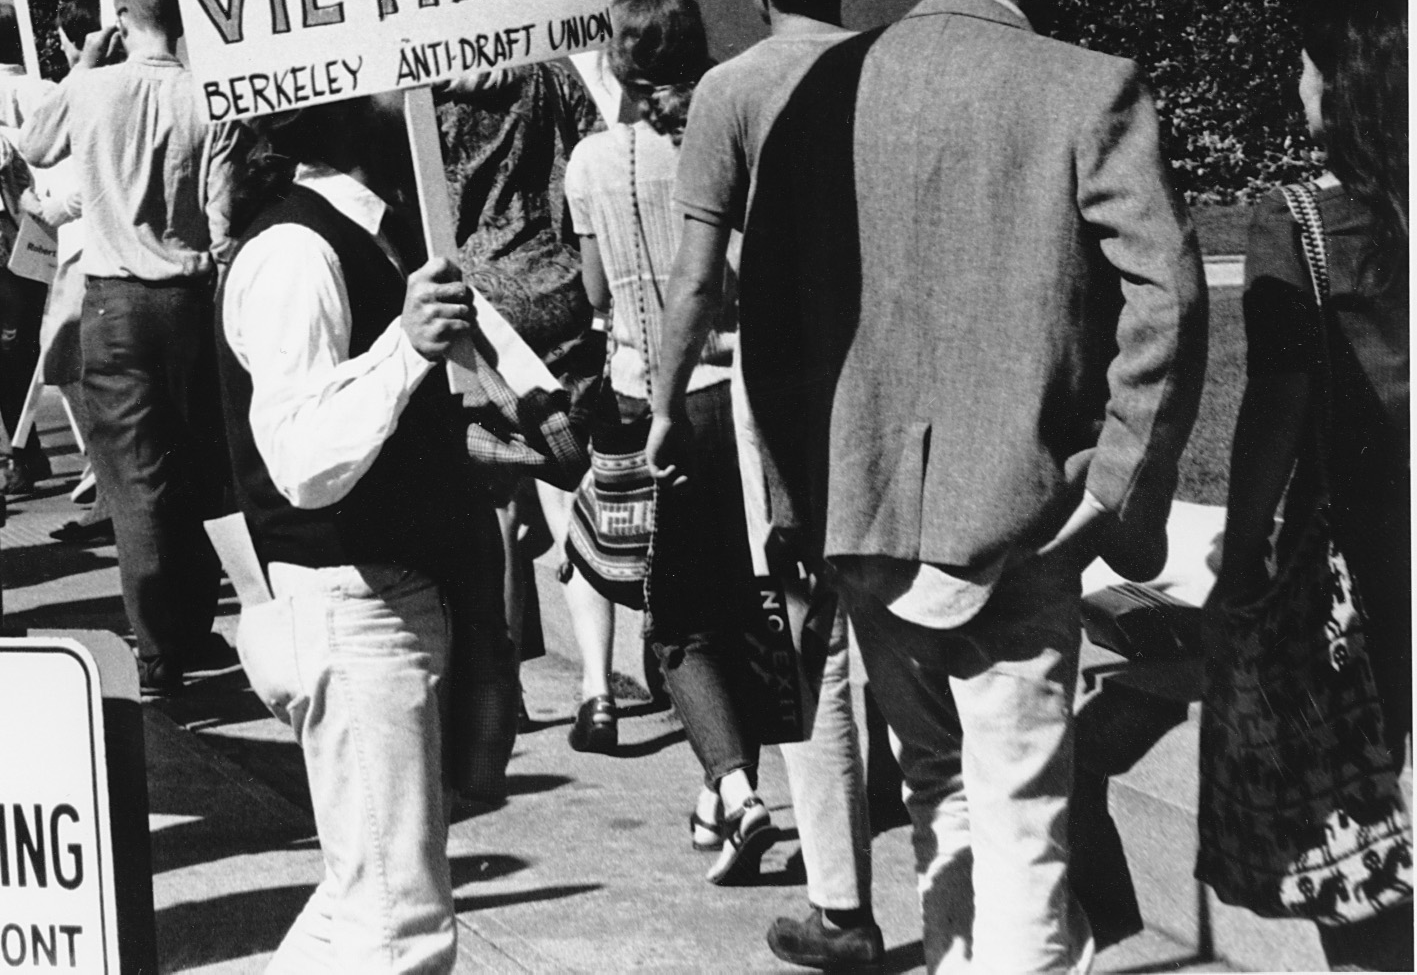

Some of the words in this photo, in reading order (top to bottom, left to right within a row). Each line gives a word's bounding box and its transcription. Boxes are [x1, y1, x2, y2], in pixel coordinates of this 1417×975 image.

[202, 55, 364, 123] BERKELEY
[547, 7, 615, 52] UNION
[759, 590, 785, 632] NO
[772, 650, 797, 724] EXIT
